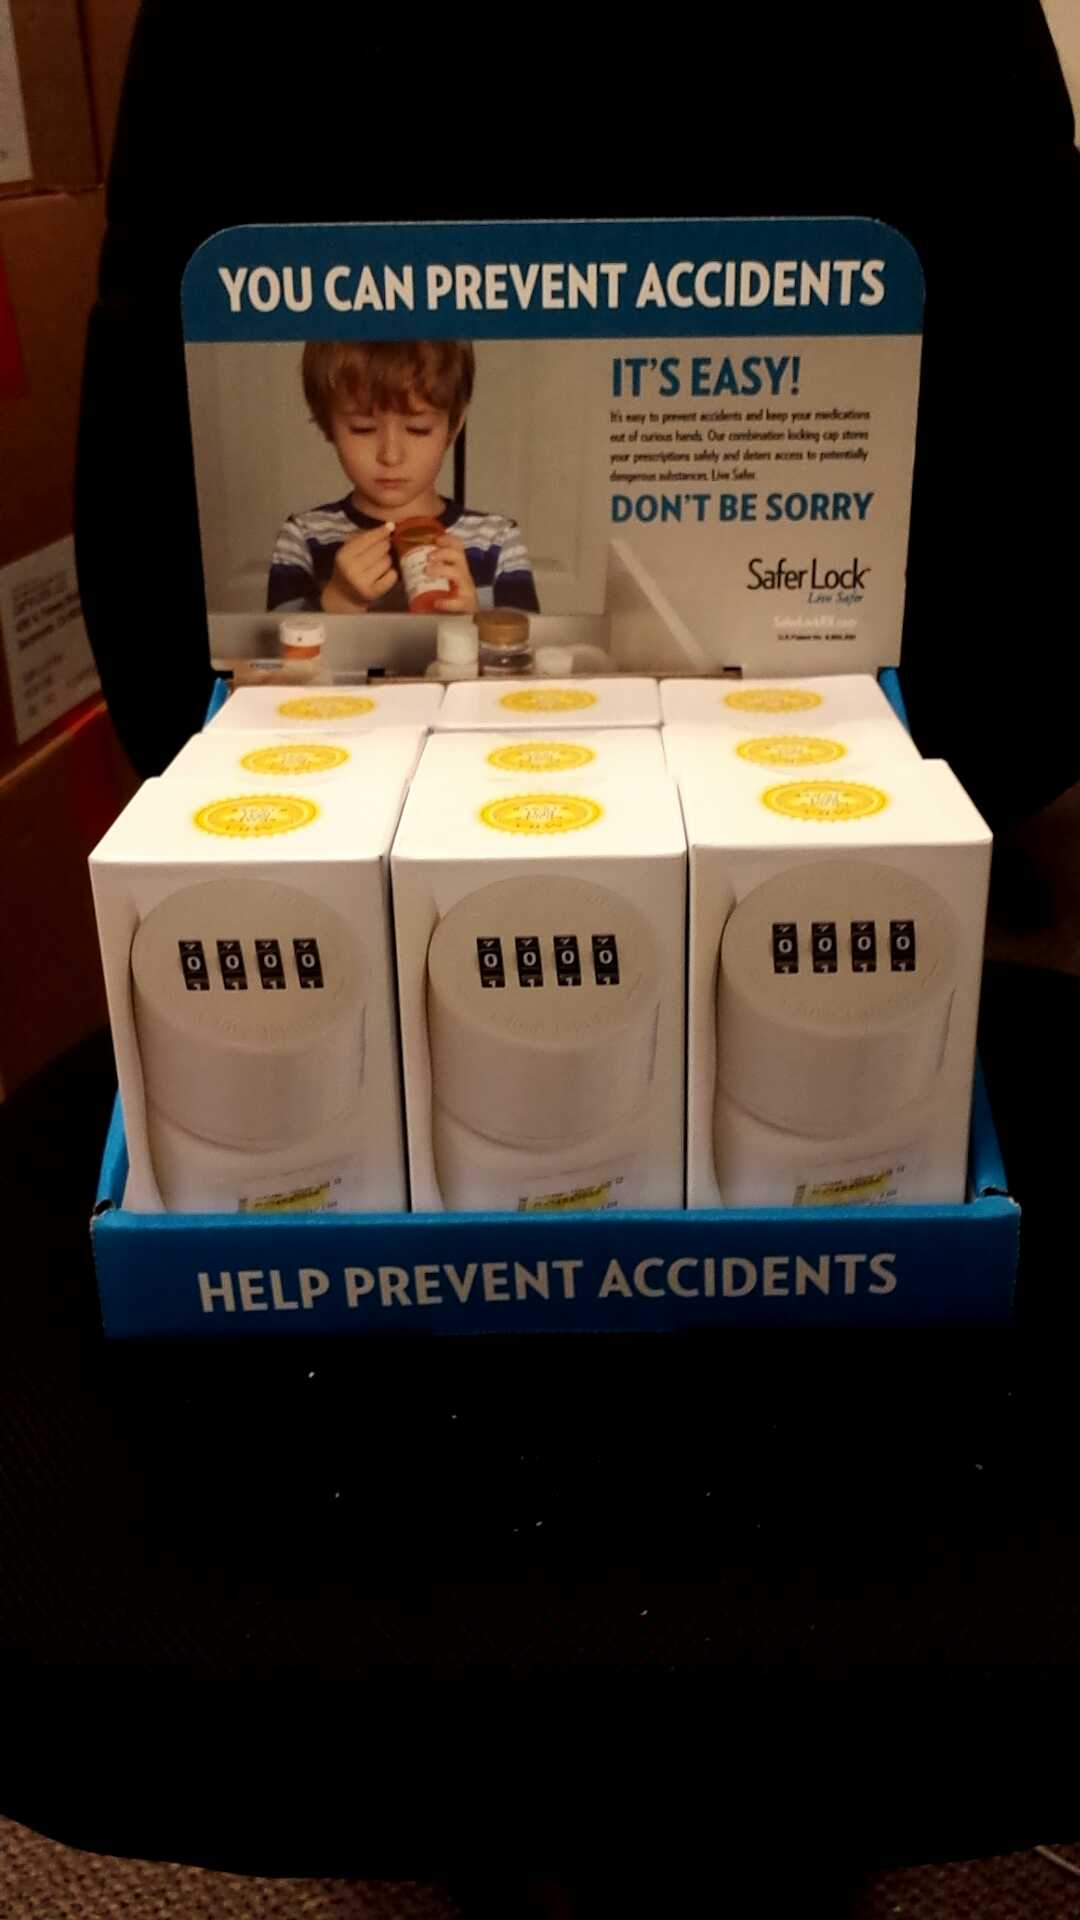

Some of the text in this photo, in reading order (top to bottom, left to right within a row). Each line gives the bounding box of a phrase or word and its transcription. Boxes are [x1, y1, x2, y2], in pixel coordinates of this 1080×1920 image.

[218, 259, 885, 313] YOU CAN PREVENT ACCIDENTS
[611, 356, 800, 397] IT'S EASY!
[626, 413, 646, 424] easy
[649, 413, 659, 422] to
[662, 413, 697, 424] prevent
[700, 409, 742, 421] accidents
[746, 409, 763, 421] and
[766, 408, 788, 422] keep
[791, 412, 811, 423] your
[815, 408, 870, 420] medications
[610, 433, 625, 442] out
[628, 430, 638, 442] of
[641, 434, 672, 442] curious
[707, 429, 725, 442] Our
[728, 430, 785, 442] combination
[787, 428, 820, 443] locking
[822, 432, 839, 442] cap
[842, 431, 869, 441] stores
[610, 448, 869, 464] your prescriptions safely and deters access to potentially
[609, 470, 656, 484] dangerous
[711, 469, 730, 481] Live
[611, 492, 874, 523] DON'T BE SORRY
[198, 1252, 898, 1314] HELP PREVENT ACCIDENTS
